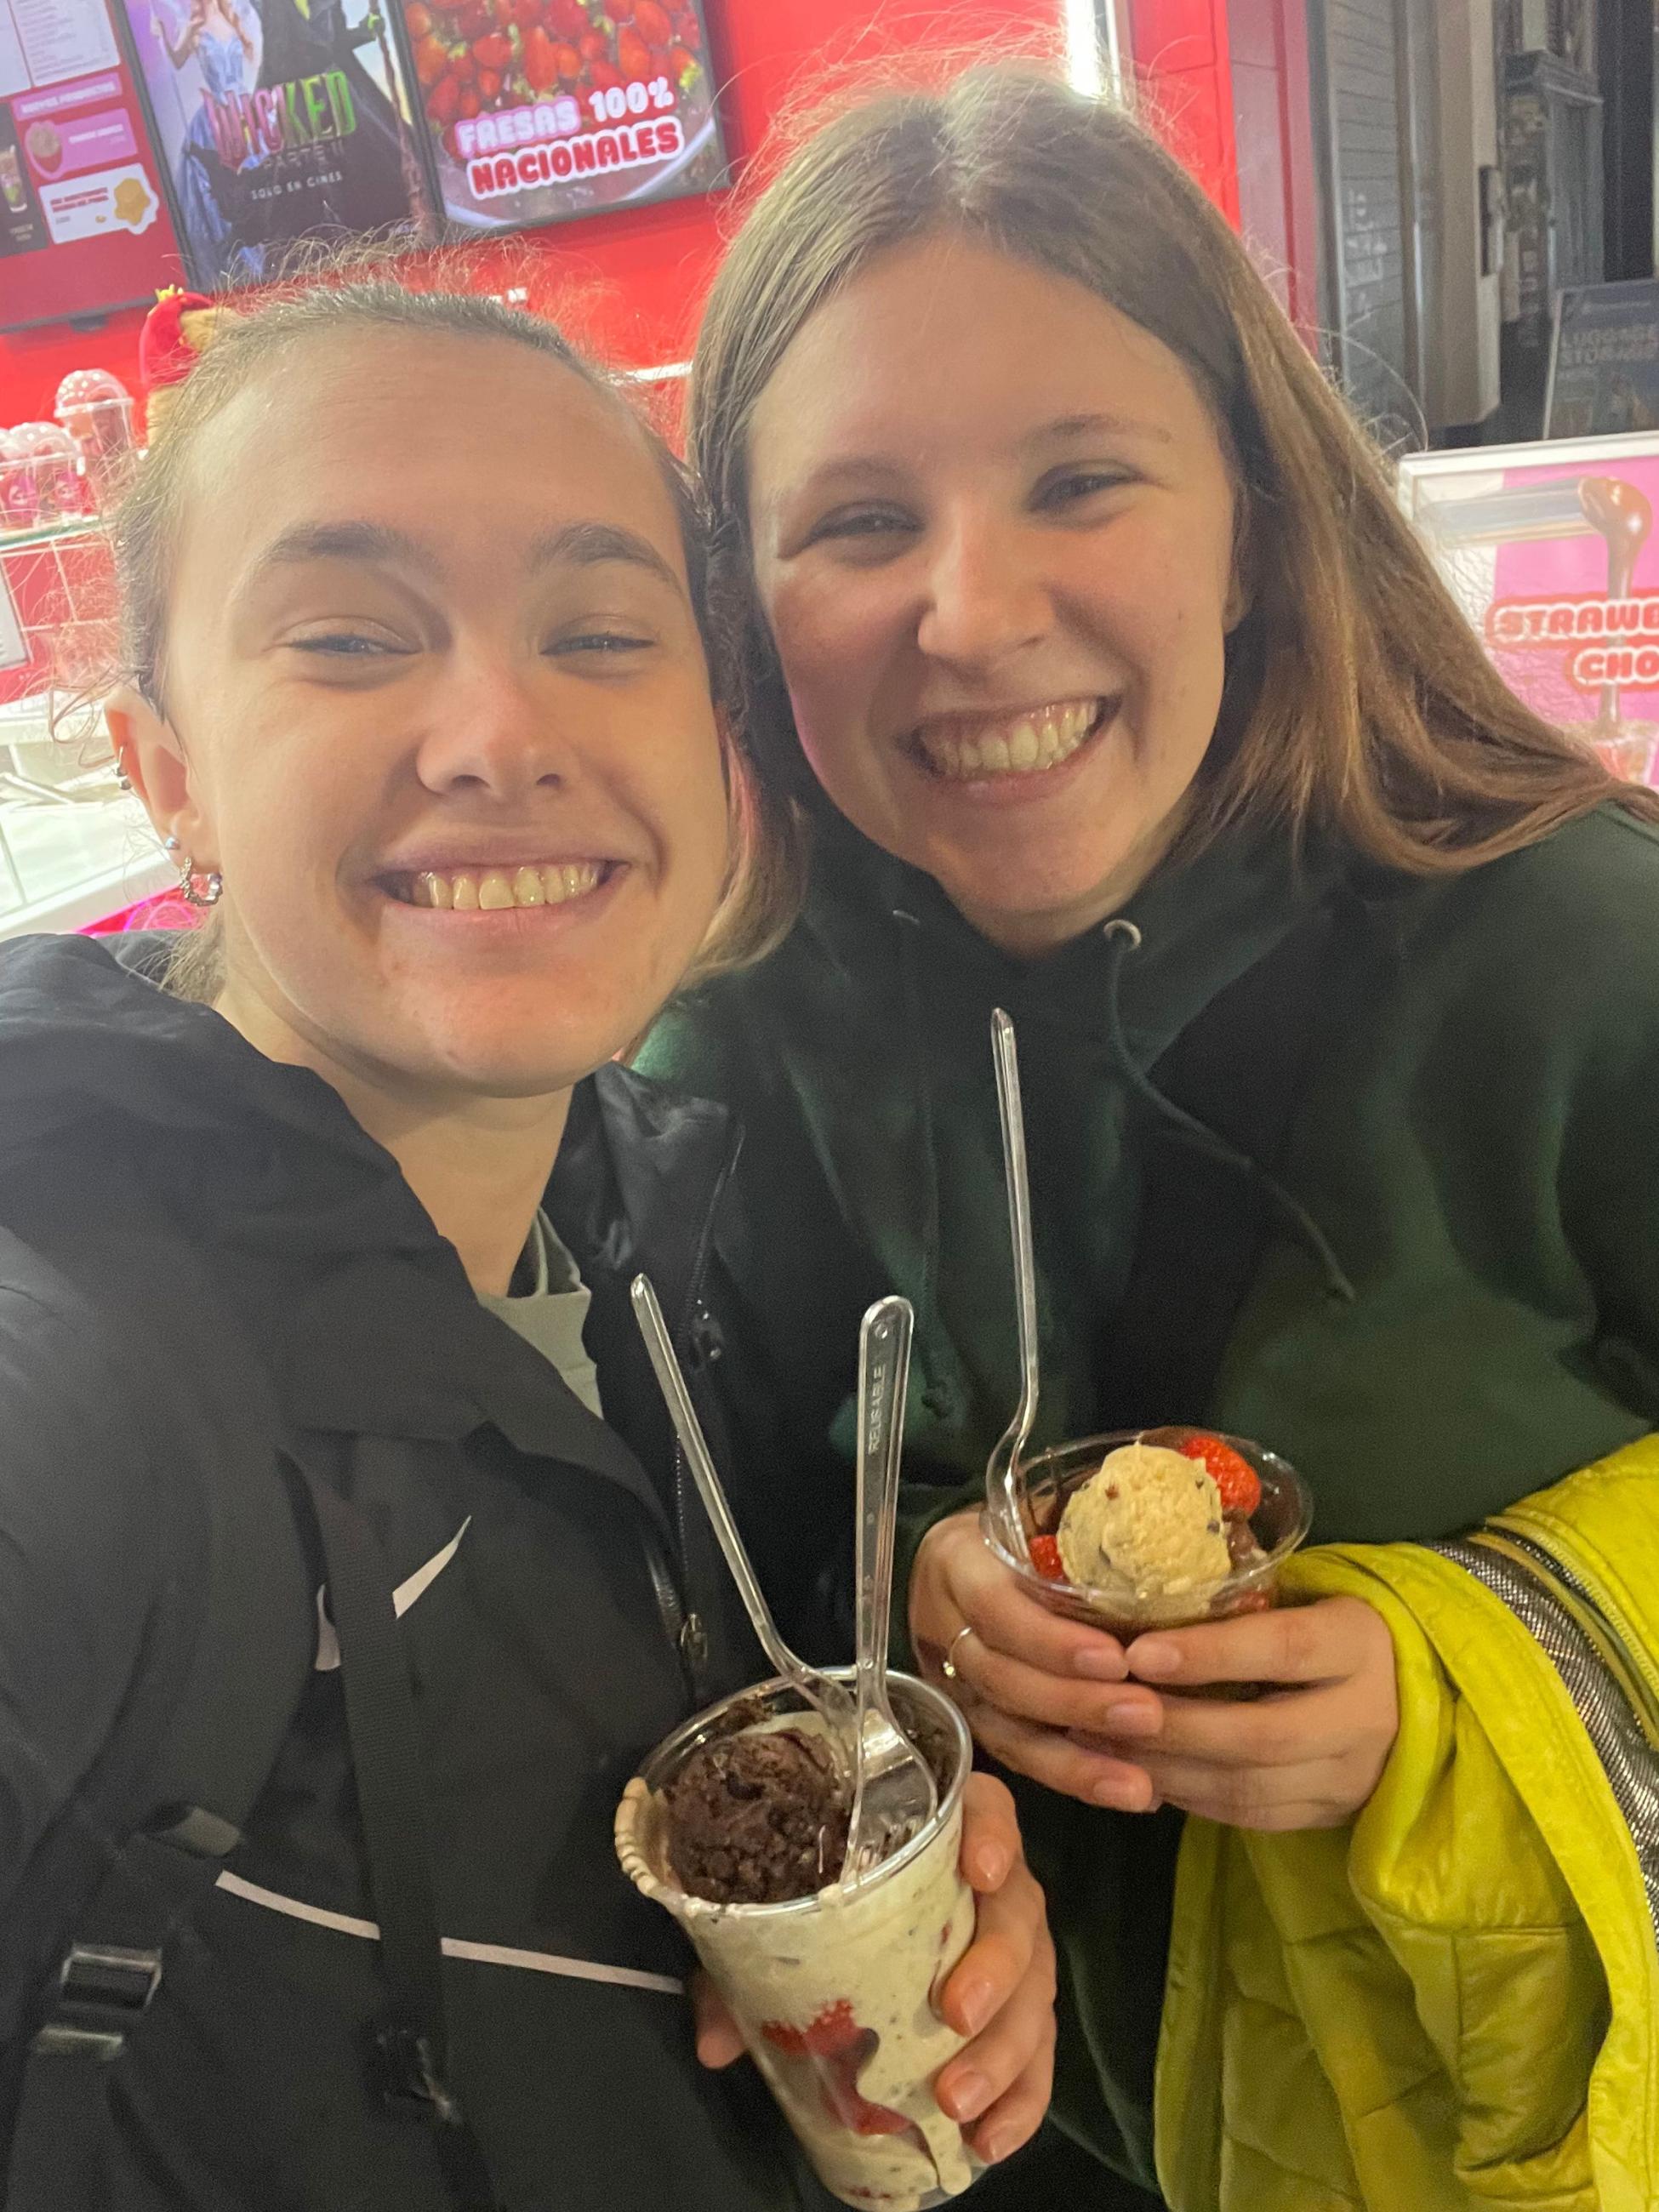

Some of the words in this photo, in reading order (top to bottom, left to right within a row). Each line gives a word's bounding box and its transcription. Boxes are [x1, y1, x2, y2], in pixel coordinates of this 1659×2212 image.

[199, 71, 356, 174] WICKED
[459, 100, 576, 153] FRESAS
[589, 77, 674, 122] 100%
[250, 185, 282, 201] SOLO
[286, 180, 302, 193] EN
[306, 171, 342, 188] CINES
[470, 120, 680, 196] NACIONALES
[1580, 649, 1659, 680] CHO
[868, 1364, 886, 1455] REUSABLE
